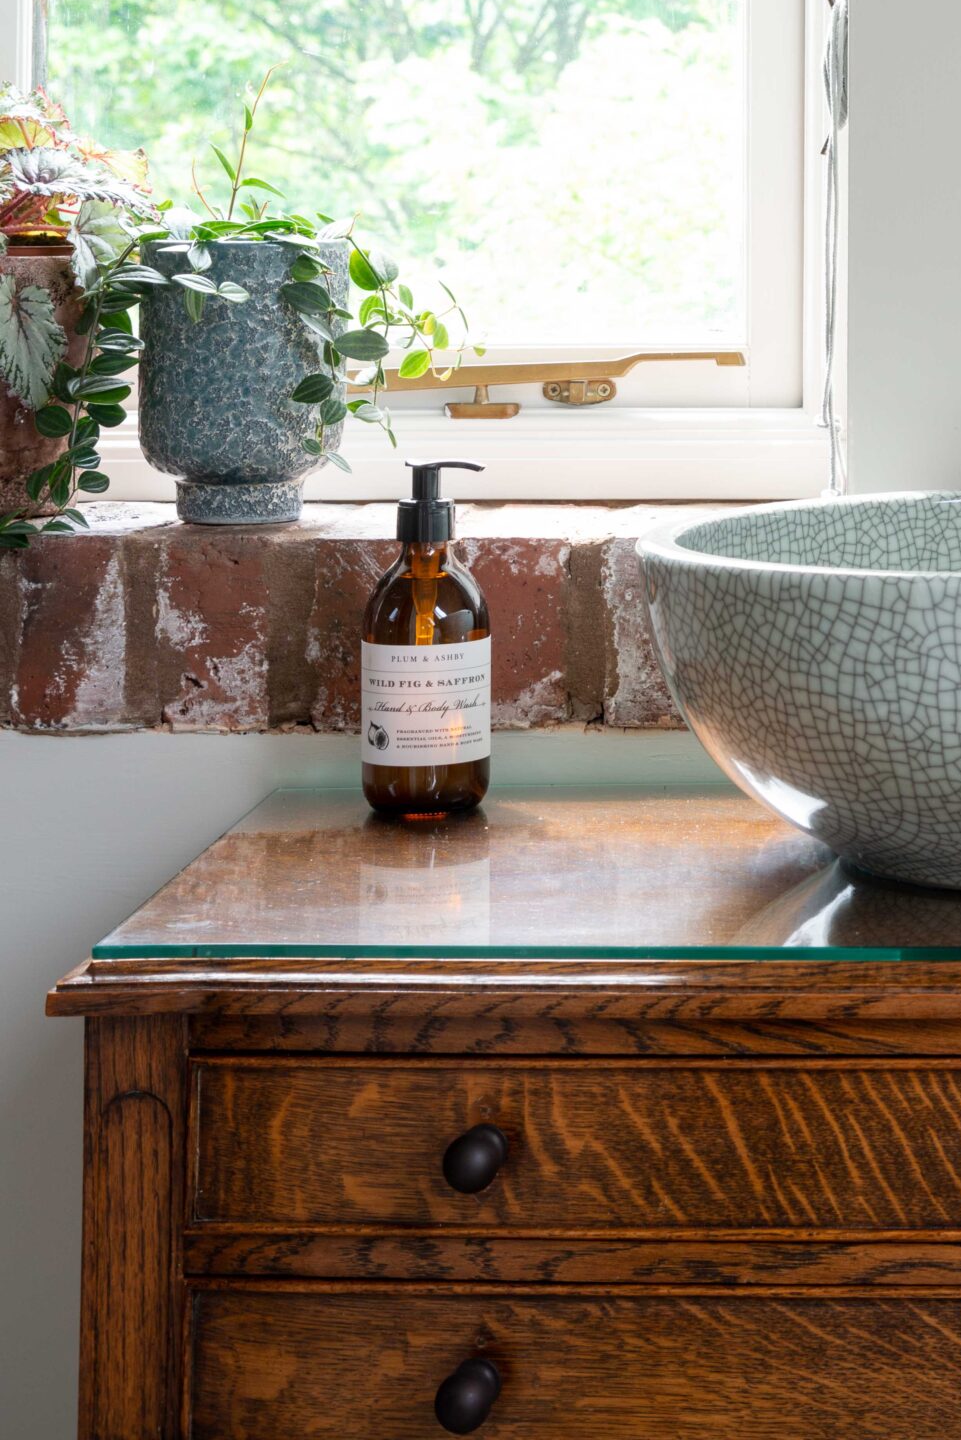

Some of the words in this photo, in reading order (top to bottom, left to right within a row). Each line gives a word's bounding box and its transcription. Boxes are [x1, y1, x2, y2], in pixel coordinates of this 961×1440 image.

[391, 655, 418, 663] PLUM
[434, 653, 465, 662] ASHBY
[368, 678, 395, 688] WILD
[399, 679, 421, 688] FIG
[425, 679, 434, 687] &
[437, 673, 486, 687] SAFFRON
[374, 700, 406, 713] Hand
[406, 704, 418, 716] &
[418, 699, 450, 719] Body
[452, 693, 480, 710] Wash
